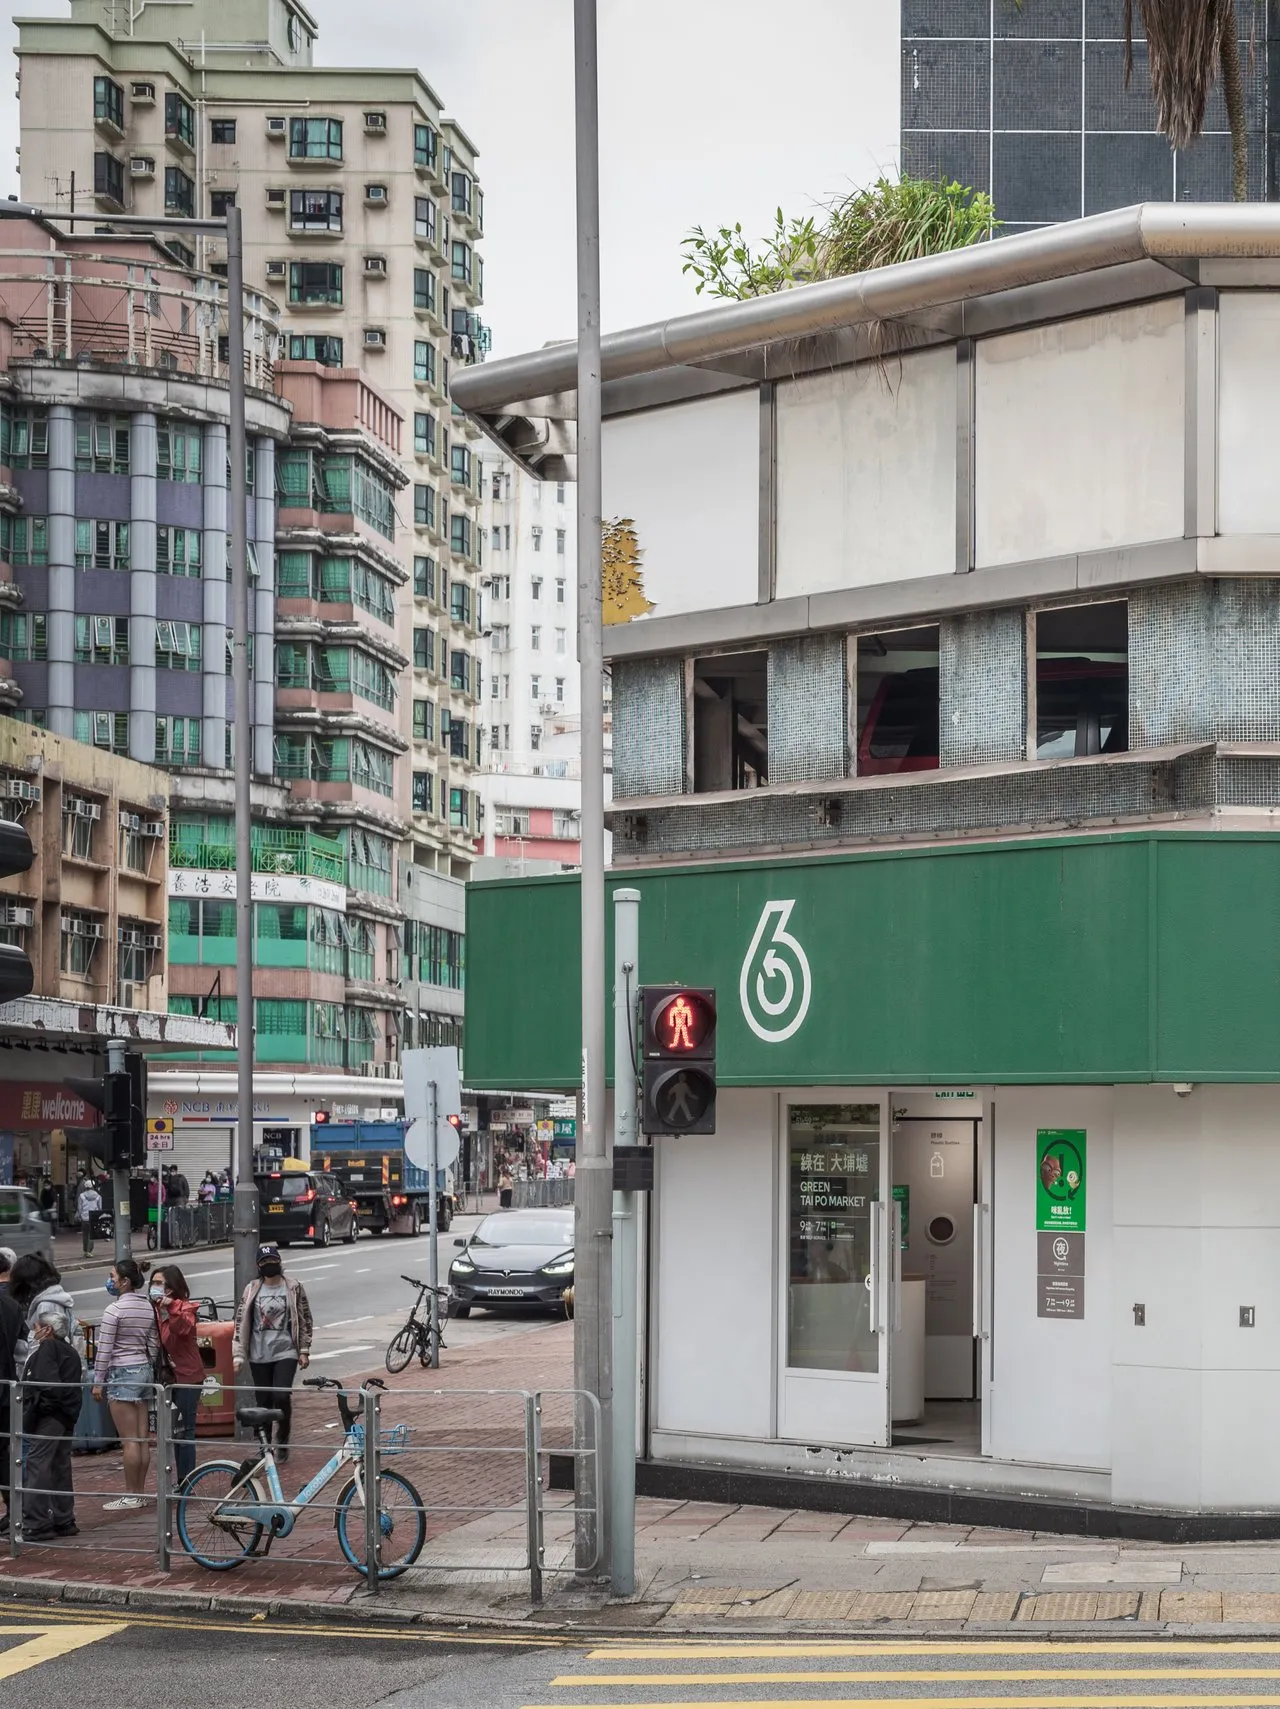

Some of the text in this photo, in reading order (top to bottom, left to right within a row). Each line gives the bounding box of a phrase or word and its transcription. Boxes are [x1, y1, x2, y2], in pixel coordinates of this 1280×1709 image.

[42, 1092, 85, 1121] wellcome
[182, 1101, 210, 1112] NCB
[800, 1153, 868, 1172] 綠在 大埔墟
[800, 1181, 830, 1192] GREEN
[801, 1195, 866, 1207] TAI PO MARKET
[488, 1288, 524, 1296] RAYMONDO
